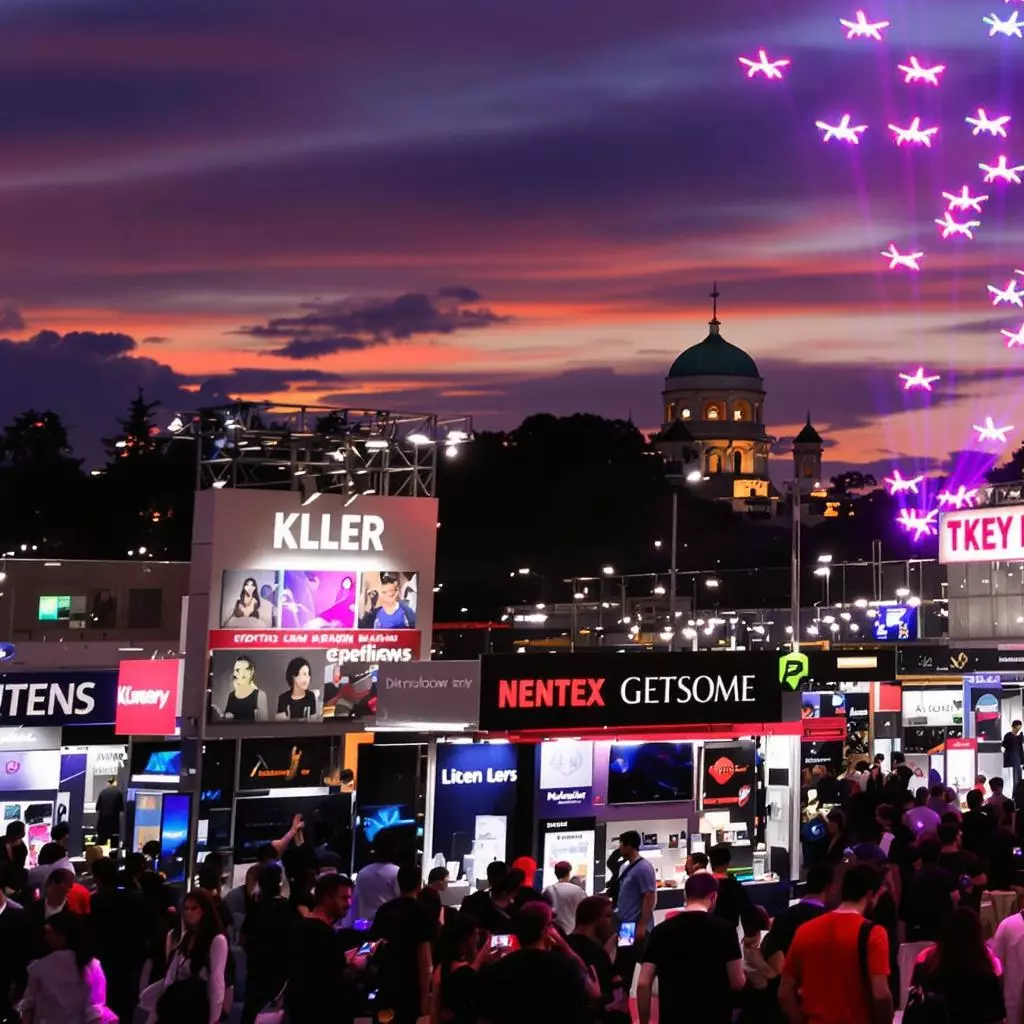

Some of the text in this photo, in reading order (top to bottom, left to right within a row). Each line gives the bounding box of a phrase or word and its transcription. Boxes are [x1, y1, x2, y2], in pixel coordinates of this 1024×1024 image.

[273, 511, 386, 552] KLLER
[946, 516, 1014, 552] TKEY
[0, 680, 97, 717] TENS
[498, 678, 606, 709] NENTEX
[619, 674, 757, 705] GETSOME
